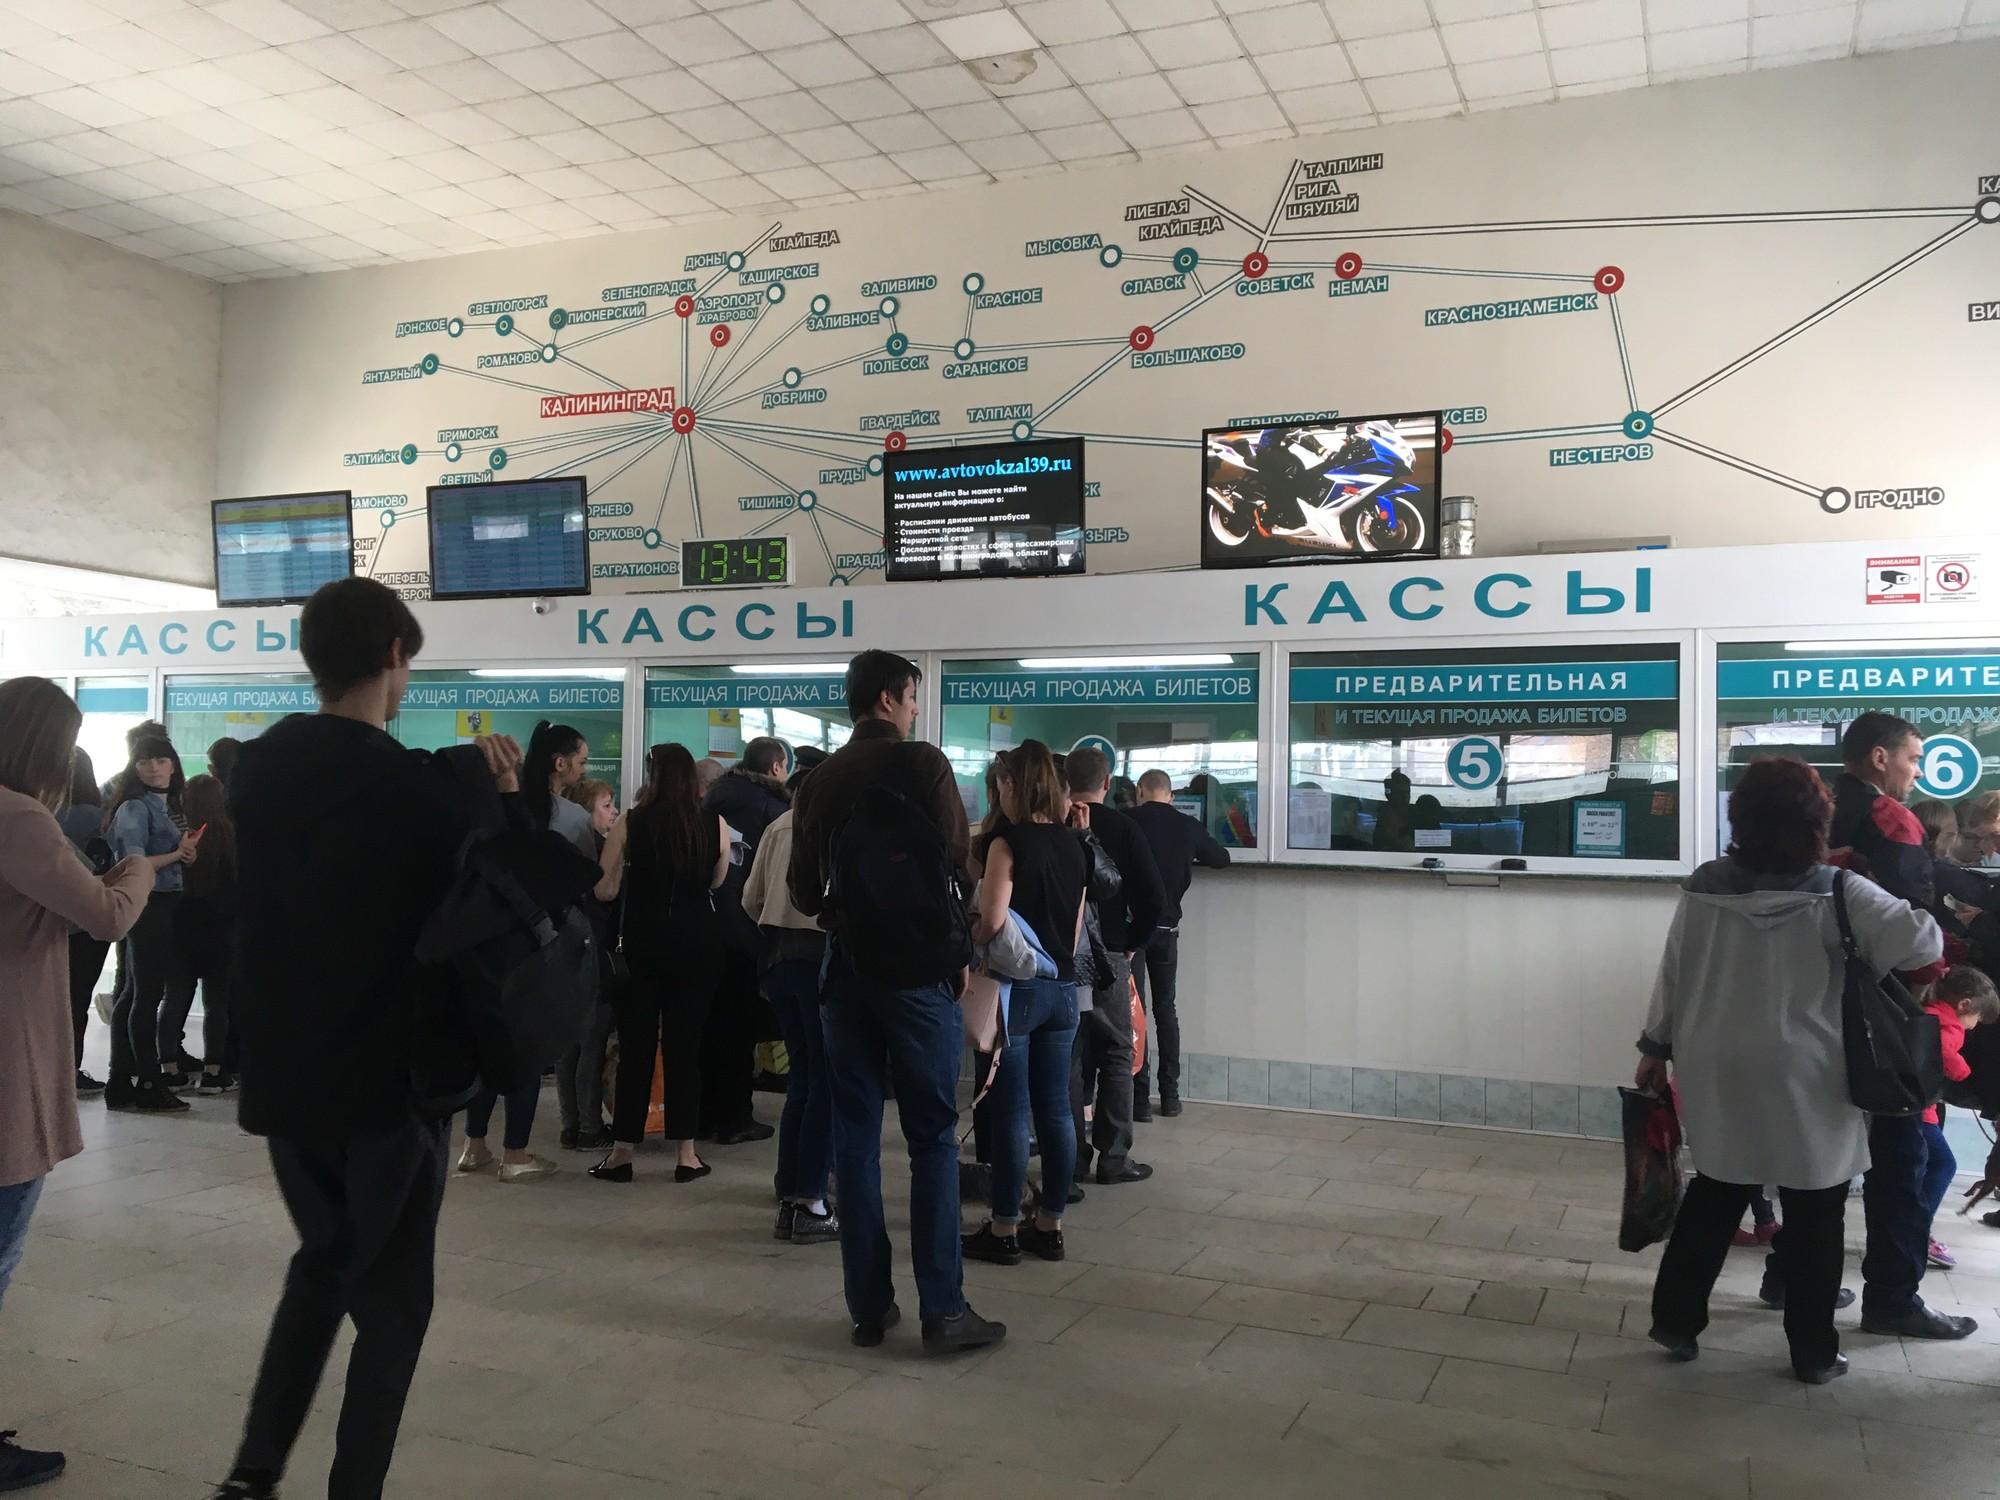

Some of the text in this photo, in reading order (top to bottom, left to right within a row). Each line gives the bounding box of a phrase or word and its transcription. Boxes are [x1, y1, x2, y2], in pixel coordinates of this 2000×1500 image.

[1306, 154, 1383, 178] ТАЛЛИНН
[1296, 181, 1340, 199] РИГА
[1126, 199, 1190, 221] ЛИЕПАЯ
[1287, 194, 1358, 219] ШЯУЛЯЙ
[1139, 216, 1223, 240] КЛАЙПЕДА
[769, 230, 839, 252] КЛАЙПЕДА
[1026, 235, 1101, 256] МЫСОВКА
[685, 252, 727, 271] ДЮНЫ
[739, 264, 818, 285] КАШИРСКОЕ
[602, 280, 696, 302] ЗЕЛЕНОГРАДСК
[862, 276, 937, 297] ЗАЛИВИНО
[1122, 276, 1185, 295] СЛАВСК
[1237, 274, 1314, 296] СОВЕТСК
[1329, 277, 1388, 297] НЕМАН
[468, 296, 548, 317] СВЕТЛОГОРСК
[697, 291, 763, 311] АЭРОПОРТ
[977, 289, 1042, 308] КРАСНОЕ
[567, 303, 647, 325] ПИОНЕРСКИЙ
[1425, 294, 1599, 325] КРАСНОЗНАМЕНСК
[396, 319, 447, 337] ДОНСКОЕ
[808, 311, 879, 331] ЗАЛИВНОЕ
[477, 351, 540, 369] РОМАНОВО
[864, 357, 929, 375] ПОЛЕССК
[1132, 344, 1245, 368] БОЛЬШАКОВО
[363, 365, 421, 384] ЯНТАРНЫЙ
[944, 357, 1028, 378] САРАНСКОЕ
[541, 388, 675, 418] КАЛИНИНГРАД
[763, 388, 826, 408] ДОБРИНО
[861, 410, 939, 430] ГВАРДЕЙСК
[968, 405, 1032, 423] ТАЛПАКИ
[1442, 408, 1487, 424] УСЕВ
[438, 426, 498, 443] ПРИМОРСК
[344, 450, 400, 467] БАЛТИЙСК
[1550, 444, 1653, 466] НЕСТЕРОВ
[439, 469, 493, 486] СВЕТЛЫЙ
[820, 468, 865, 484] ПРУДЫ
[894, 456, 1072, 482] www.avtovokzal39.ru
[740, 496, 794, 511] ТИШИНО
[1856, 489, 1945, 509] ГРОДНО
[586, 504, 632, 517] ОРНЕВО
[588, 526, 644, 542] ОРУКОВО
[1086, 527, 1129, 543] ЗЫРЬ
[353, 539, 376, 550] ОНГ
[593, 562, 681, 577] БАГРАТИОНОВ
[701, 541, 786, 582] 13:43
[837, 552, 886, 569] ПРАВДИ
[374, 572, 430, 585] БИЛЕФЕЛЬ
[1244, 566, 1651, 626] КАССЫ
[577, 599, 854, 645] КАССЫ
[83, 617, 300, 657] КАССЫ
[947, 677, 1251, 701] ТЕКУЩАЯ ПРОДАЖА БИЛЕТОВ
[1335, 671, 1628, 697] ПРЕДВАРИТЕЛЬНАЯ
[169, 692, 228, 708] ТЕКУЩАЯ
[234, 691, 298, 707] ПРОДАЖА
[400, 687, 620, 707] ЕКУЩАЯ ПРОДАЖА БИЛЕТОВ
[651, 686, 728, 705] ТЕКУЩАЯ
[737, 684, 821, 704] ПРОДАЖА
[1335, 706, 1628, 727] И ТЕКУЩАЯ ПРОДАЖА БИЛЕТОВ
[1773, 708, 1788, 723] И
[1900, 707, 2000, 726] ПРОДАЖ
[1458, 744, 1492, 785] 5
[1924, 745, 1964, 790] 6
